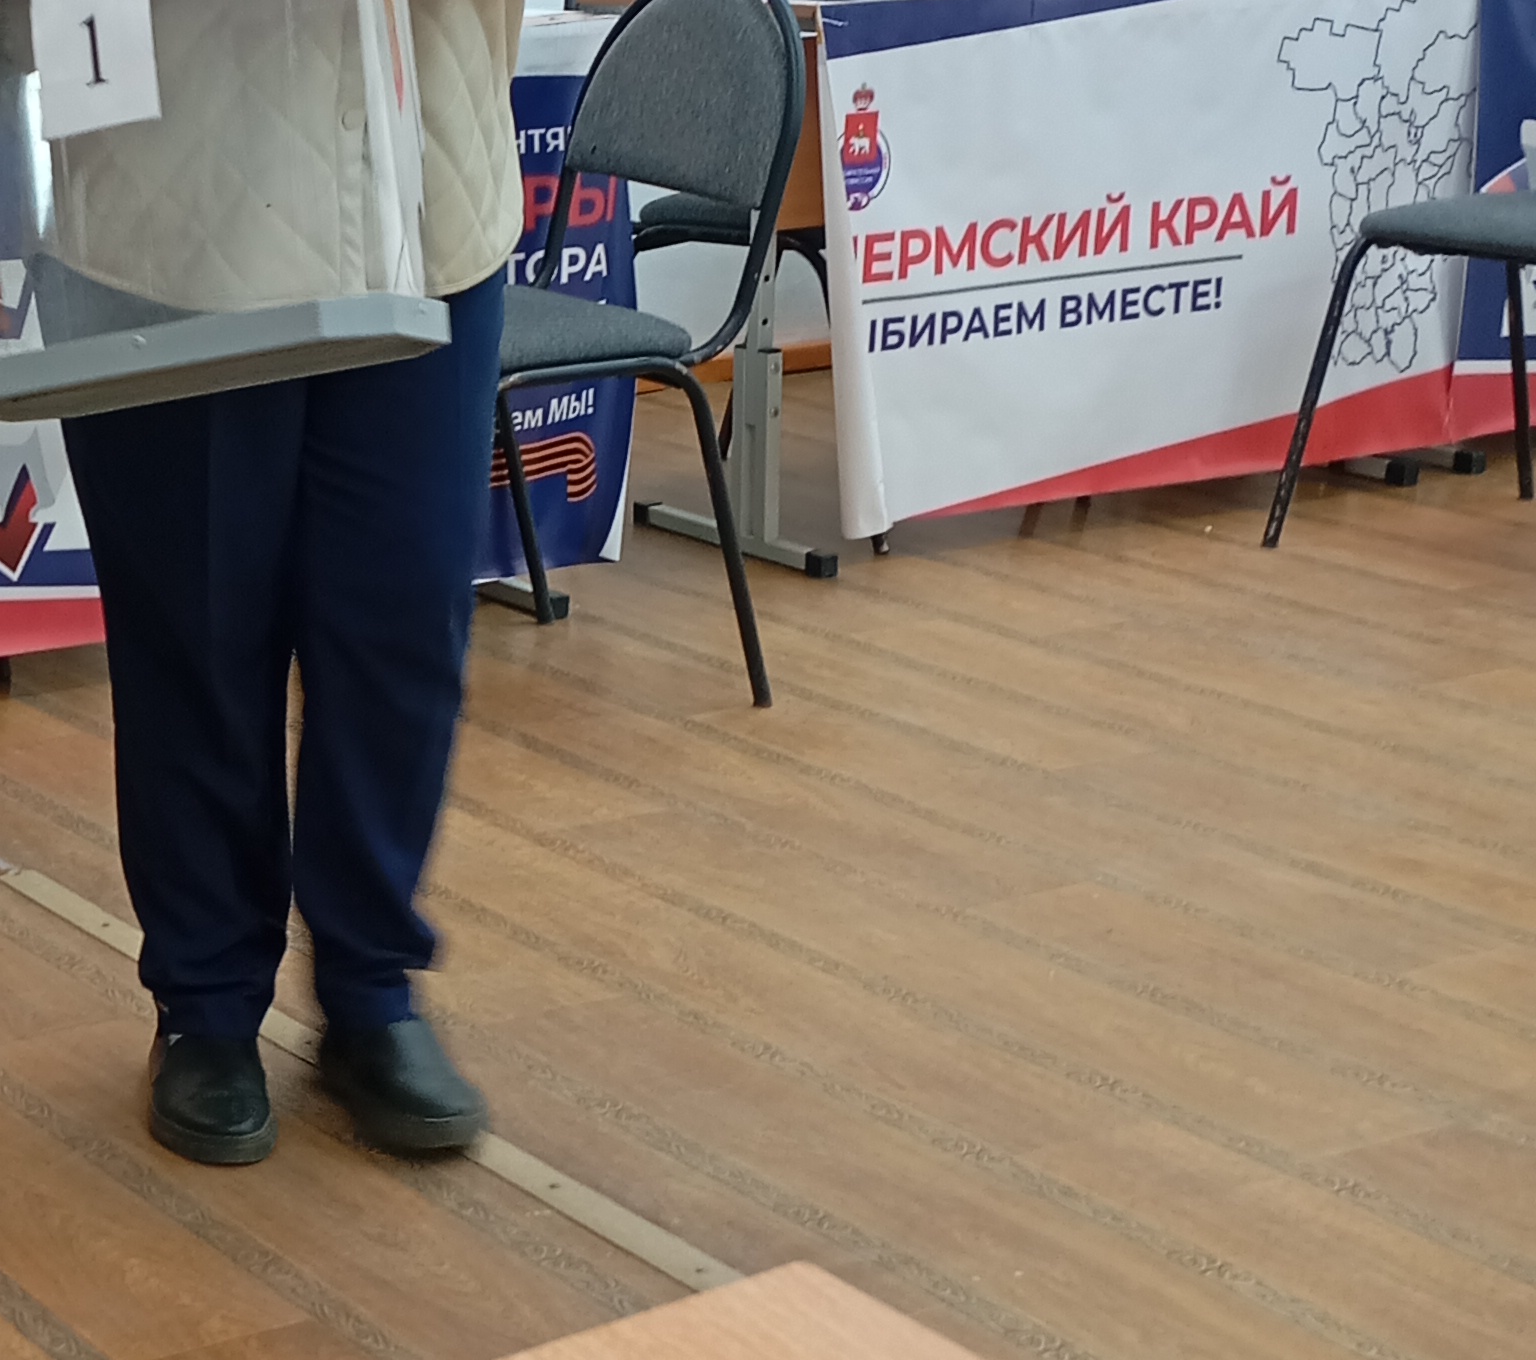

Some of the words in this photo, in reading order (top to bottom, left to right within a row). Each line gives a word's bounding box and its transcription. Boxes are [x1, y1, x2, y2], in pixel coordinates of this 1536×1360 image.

[80, 13, 109, 87] 1
[853, 191, 1131, 284] ЕРМСКИЙ
[1149, 175, 1298, 250] КРАЙ
[868, 298, 1046, 353] БИРАЕМ
[1060, 277, 1223, 329] ВМЕСТЕ!
[547, 388, 595, 425] МЫ!
